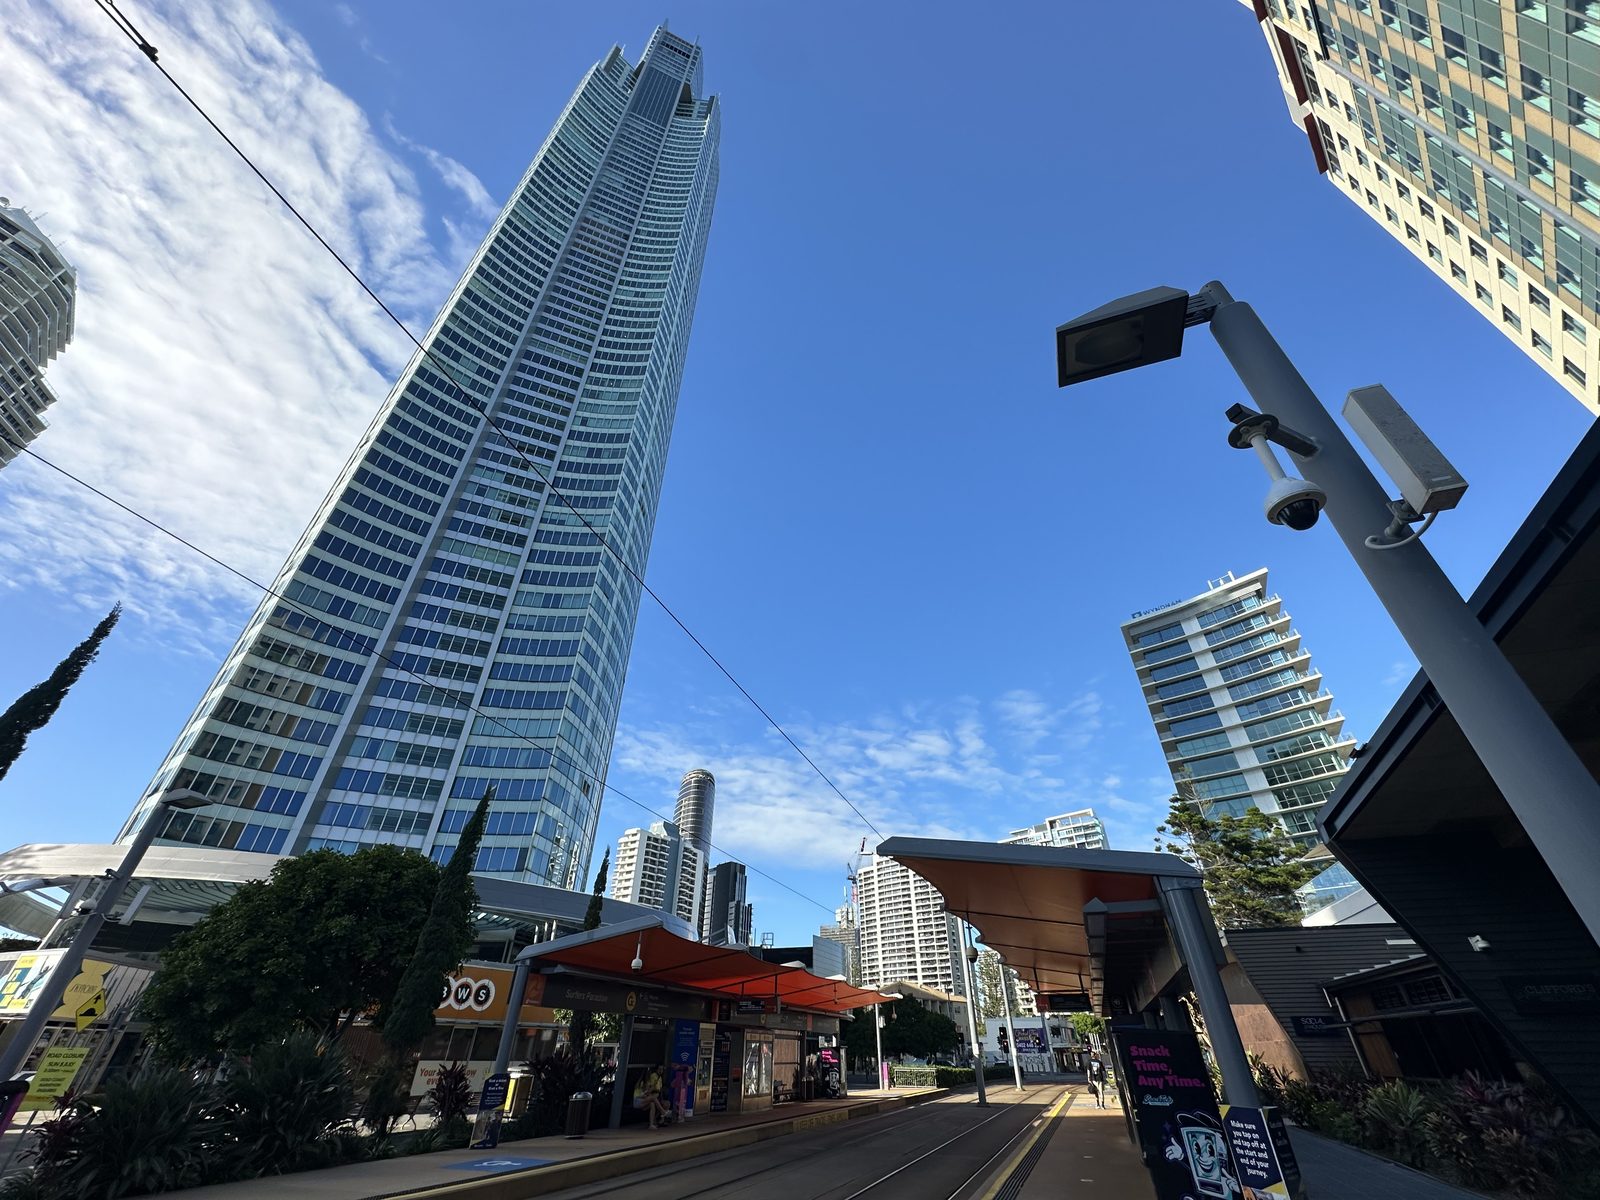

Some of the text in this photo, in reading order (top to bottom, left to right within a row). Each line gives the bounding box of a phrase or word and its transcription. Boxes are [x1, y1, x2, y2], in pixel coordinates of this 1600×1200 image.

[1143, 599, 1182, 615] WYNDHAM
[1129, 1045, 1170, 1057] Snack
[1133, 1060, 1173, 1075] Time,
[1138, 1075, 1206, 1089] Any Time.
[1230, 1120, 1244, 1128] Make
[1242, 1131, 1251, 1139] tap
[1242, 1140, 1251, 1148] tap
[1251, 1140, 1259, 1148] off
[1260, 1142, 1267, 1150] at
[1235, 1147, 1268, 1159] the start and
[1240, 1157, 1269, 1169] end of your
[1246, 1166, 1268, 1179] journey.
